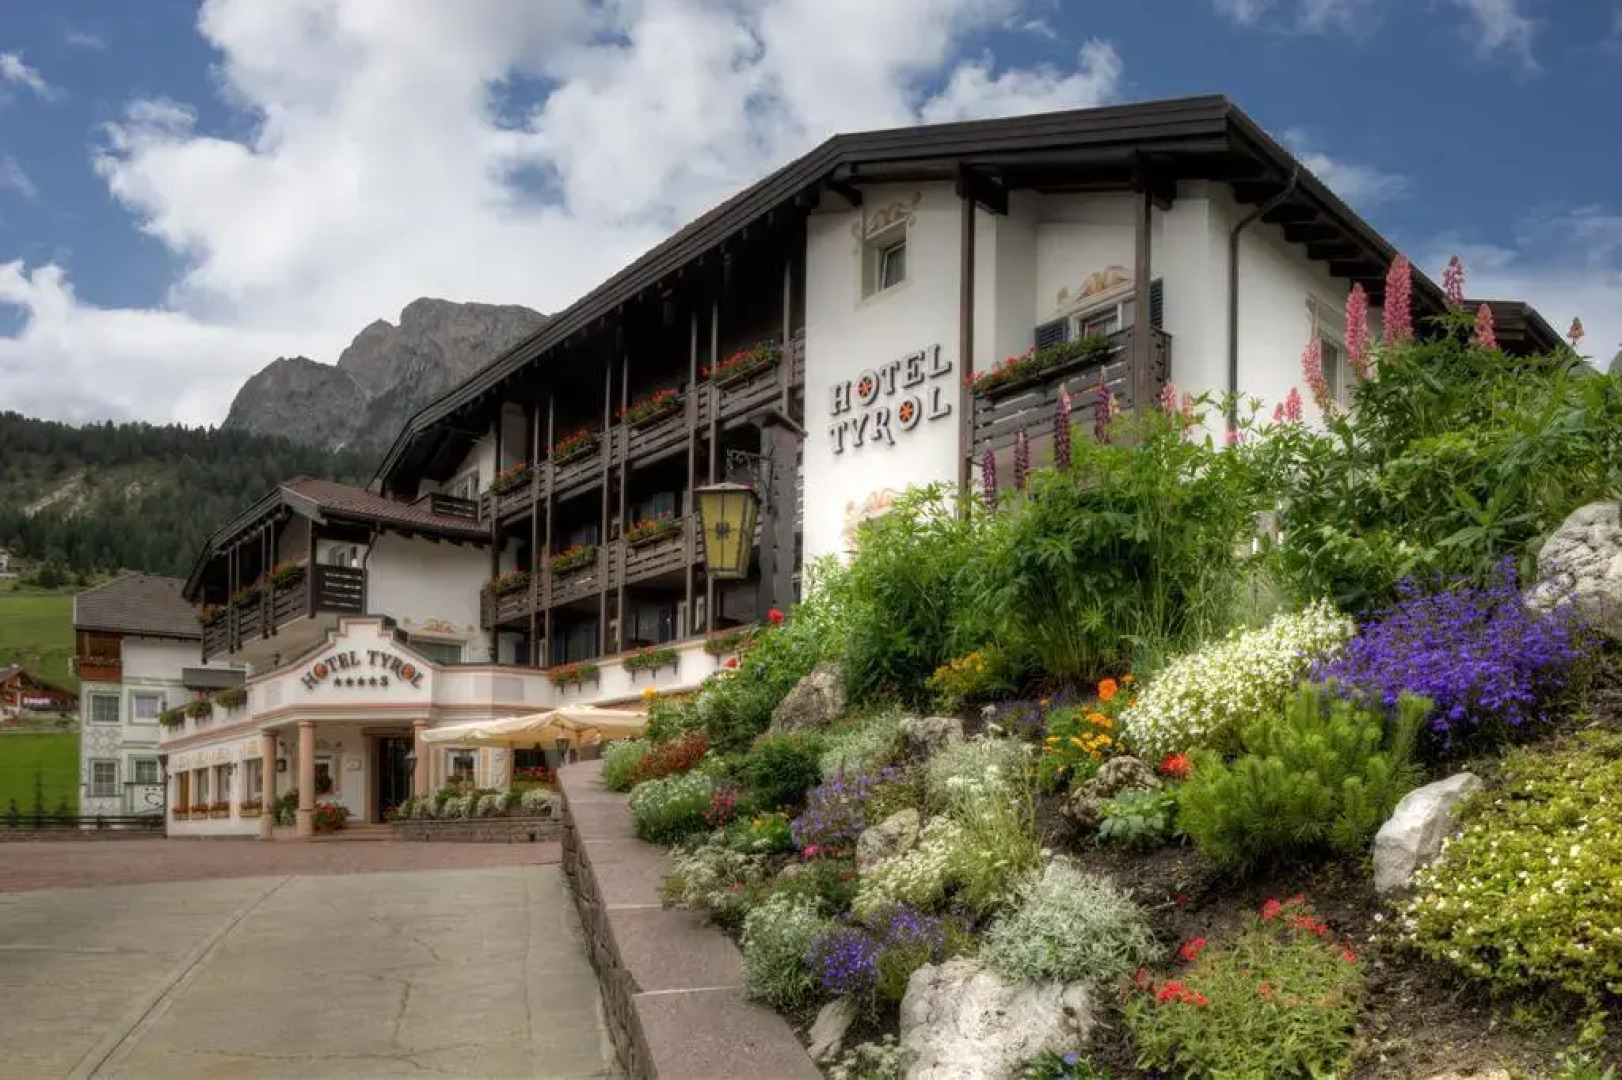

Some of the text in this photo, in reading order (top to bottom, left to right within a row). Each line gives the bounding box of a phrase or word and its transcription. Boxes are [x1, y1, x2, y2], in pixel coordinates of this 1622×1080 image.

[829, 344, 952, 416] HOTEL
[829, 387, 952, 455] TYROL
[301, 650, 423, 690] HOTEL TYROL
